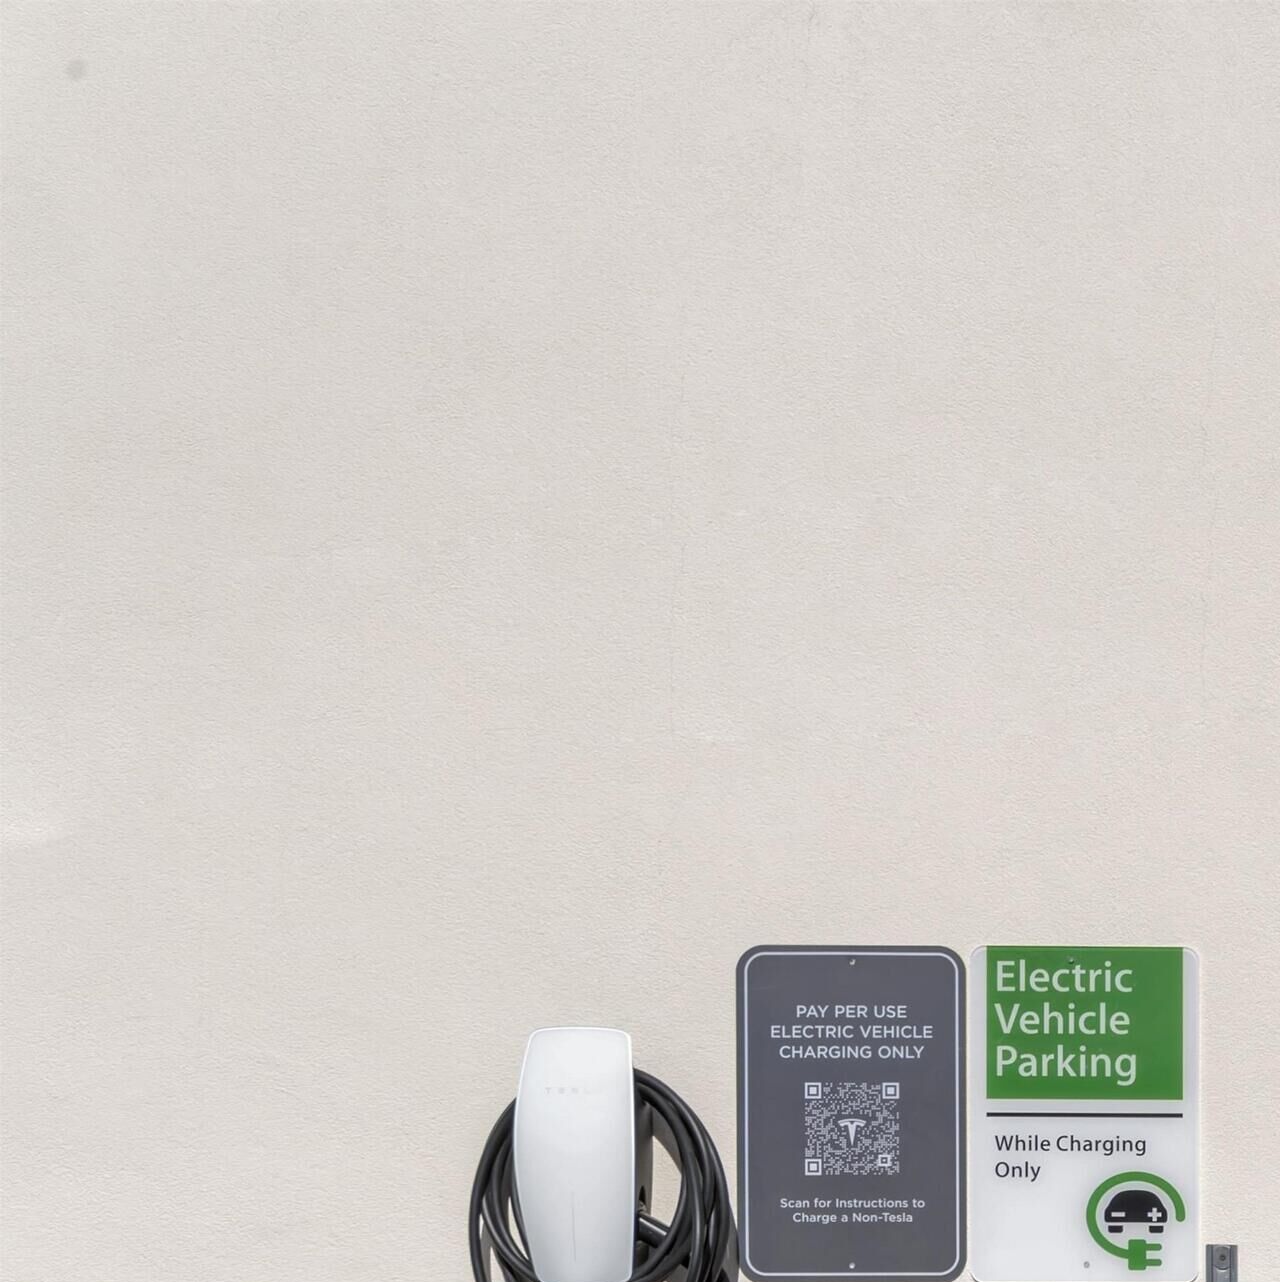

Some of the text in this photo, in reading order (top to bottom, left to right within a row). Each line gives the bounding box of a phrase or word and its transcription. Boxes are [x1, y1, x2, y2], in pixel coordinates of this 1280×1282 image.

[996, 958, 1133, 993] Electric
[796, 1004, 908, 1019] PAY PER USE
[994, 1001, 1131, 1035] Vehicle
[770, 1024, 933, 1039] ELECTRIC VEHICLE
[779, 1045, 925, 1059] CHARGING ONLY
[996, 1044, 1137, 1087] Parking
[994, 1134, 1146, 1157] While Charging
[994, 1160, 1041, 1183] Only
[780, 1197, 926, 1209] Scan for Instructions to
[792, 1212, 913, 1225] Charge a Non-Tesla
